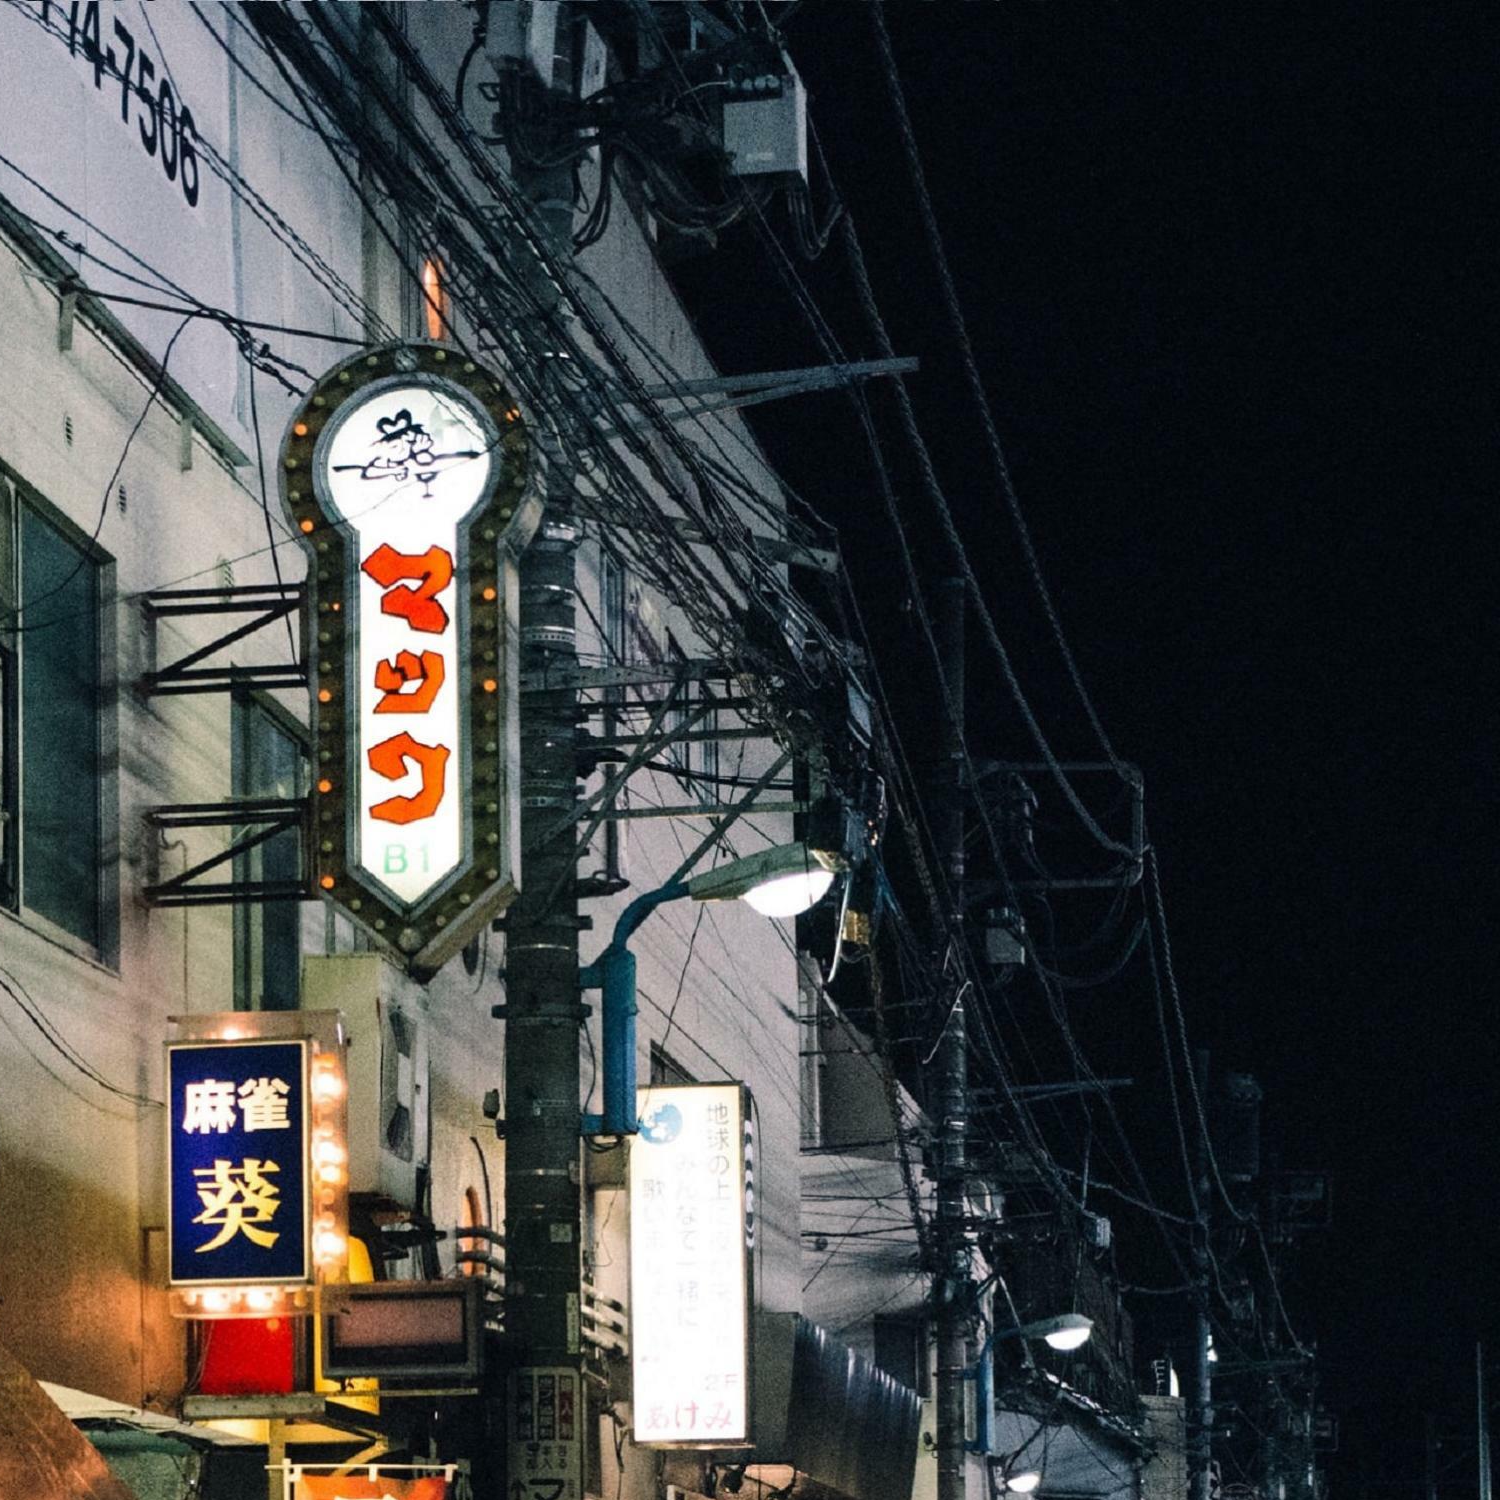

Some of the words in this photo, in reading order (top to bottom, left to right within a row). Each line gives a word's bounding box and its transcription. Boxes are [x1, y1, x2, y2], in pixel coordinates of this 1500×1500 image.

[42, 0, 199, 207] 4-7506
[383, 844, 431, 874] B1
[182, 1077, 291, 1135] 麻雀
[192, 1157, 282, 1254] 葵
[644, 1401, 733, 1430] あけみ
